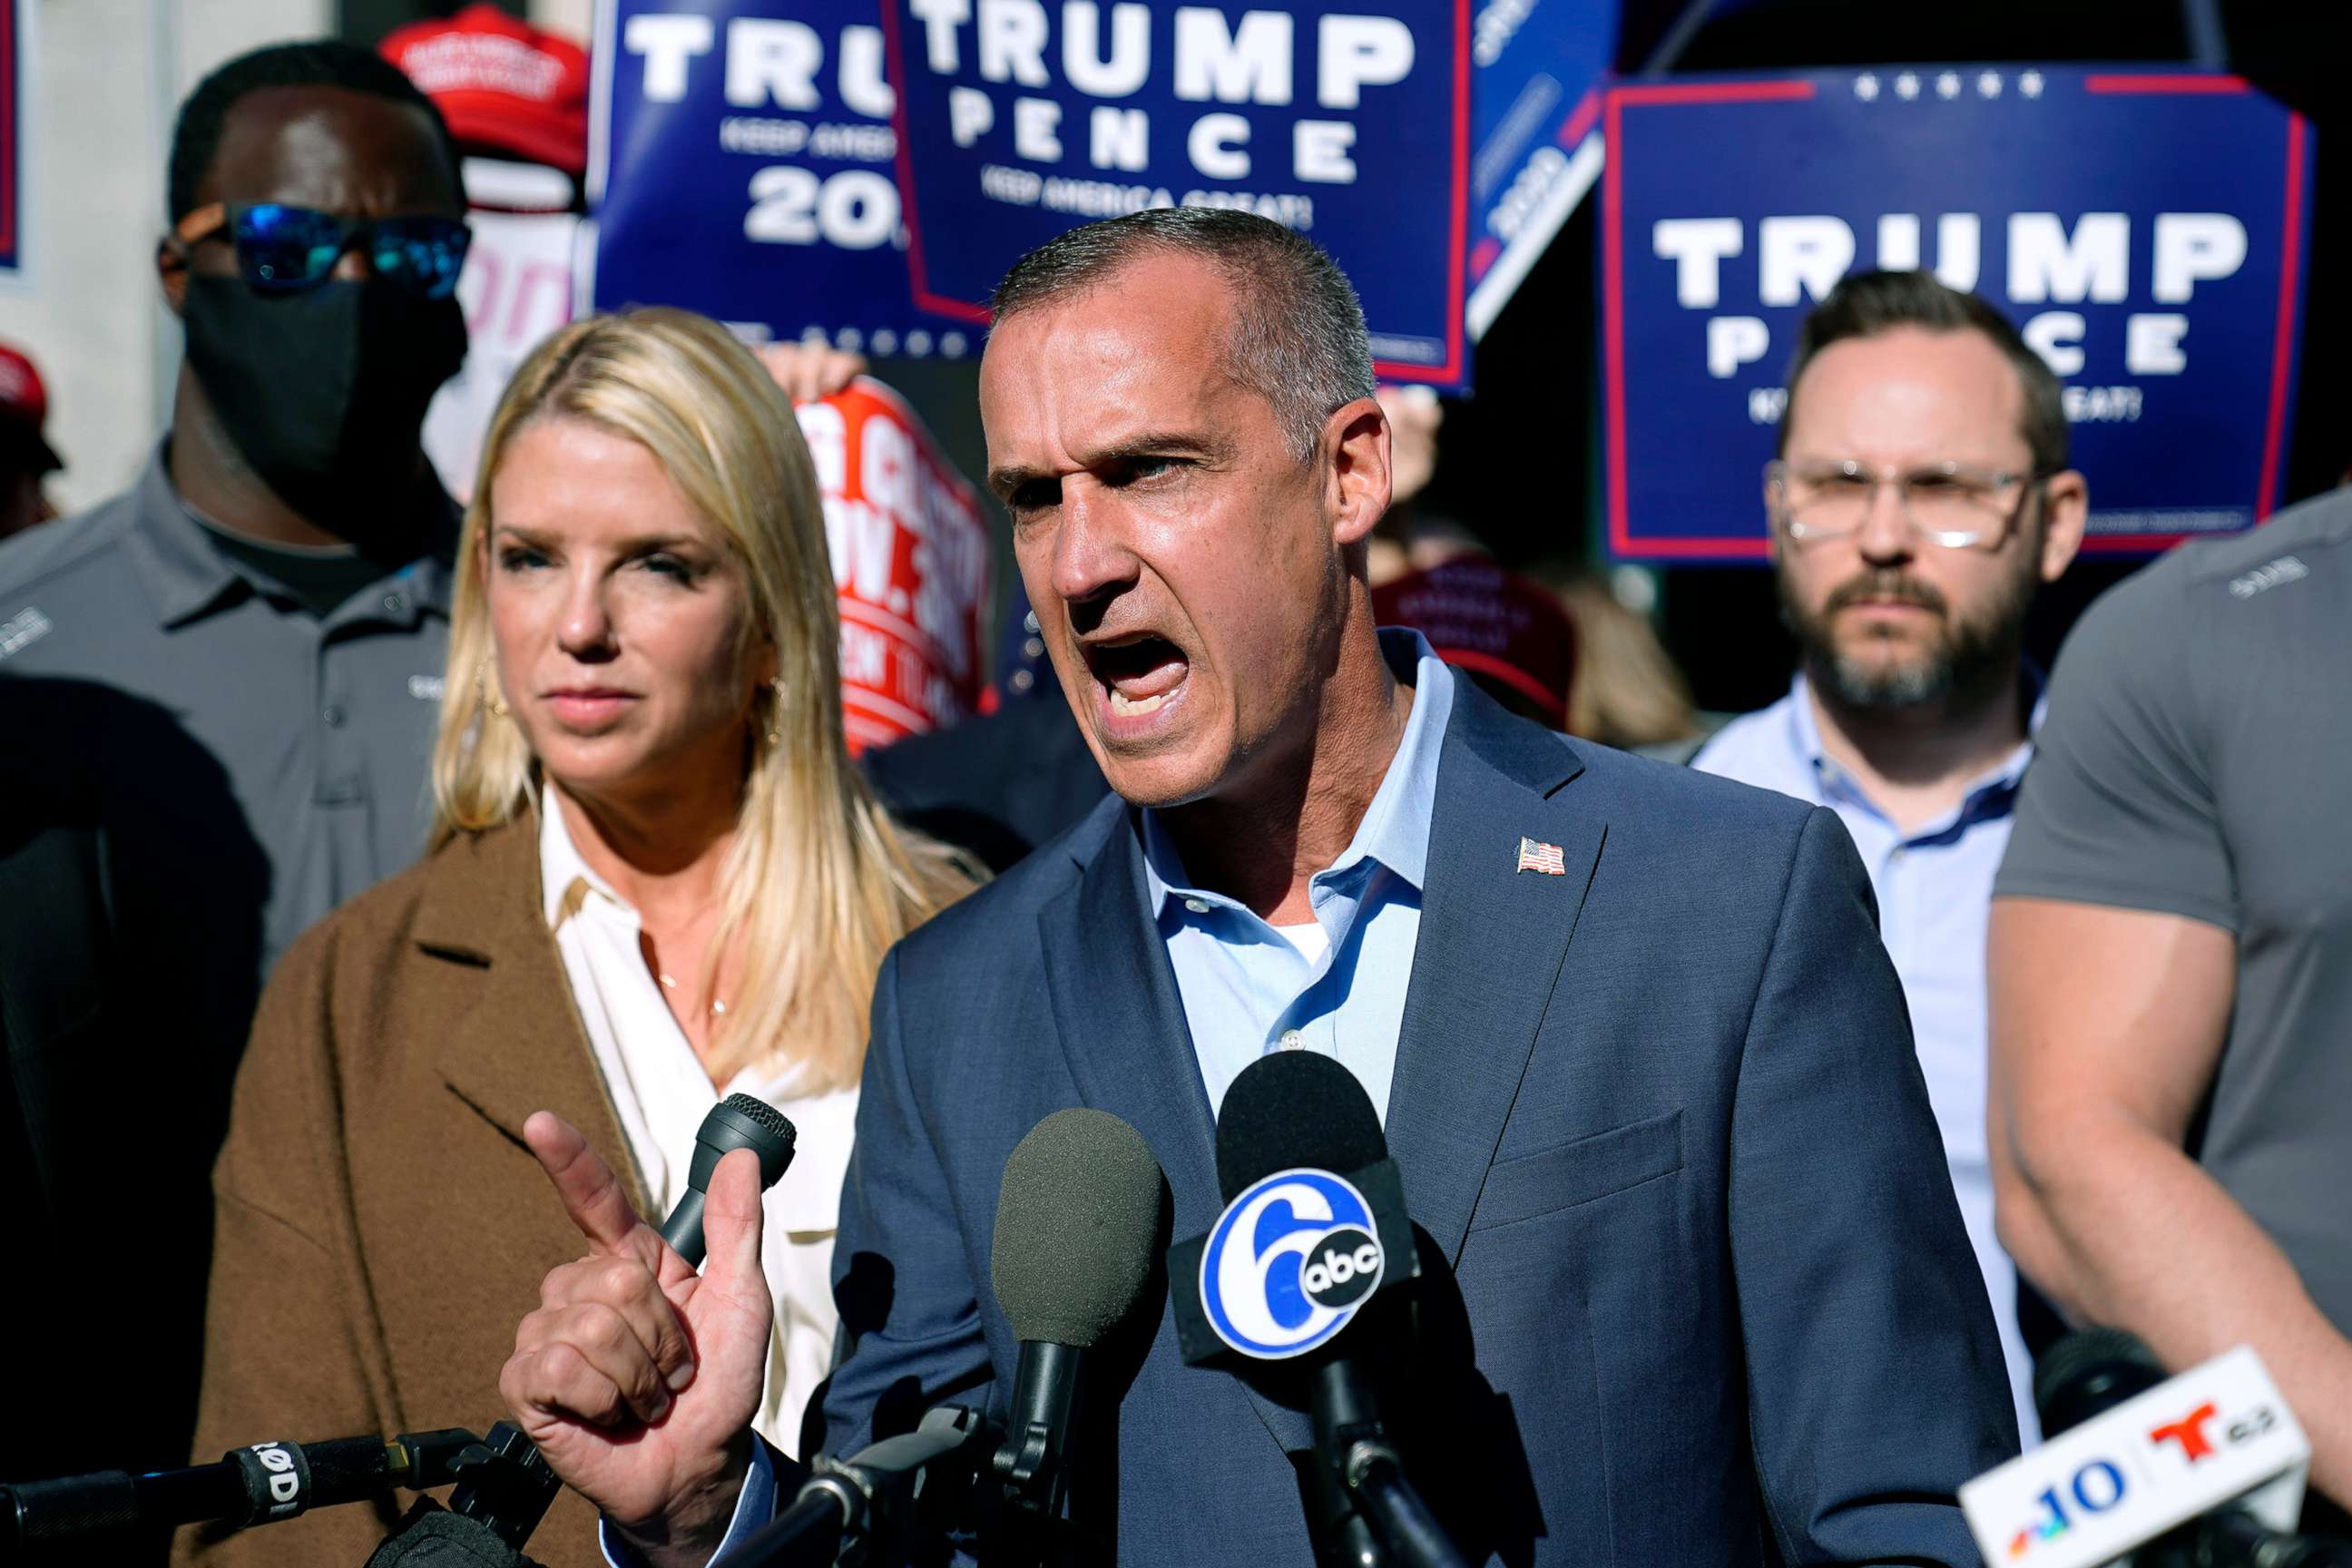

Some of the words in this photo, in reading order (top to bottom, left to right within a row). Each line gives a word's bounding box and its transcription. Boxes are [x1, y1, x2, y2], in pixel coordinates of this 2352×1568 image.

[624, 14, 896, 118] TRU
[910, 0, 1416, 109] TRUMP
[949, 86, 1357, 183] PENCE
[743, 165, 910, 250] 20
[1651, 211, 2249, 309] TRUMP
[1706, 311, 2190, 378] PCE
[1304, 1243, 1380, 1293] abc
[2038, 1461, 2126, 1530] 10
